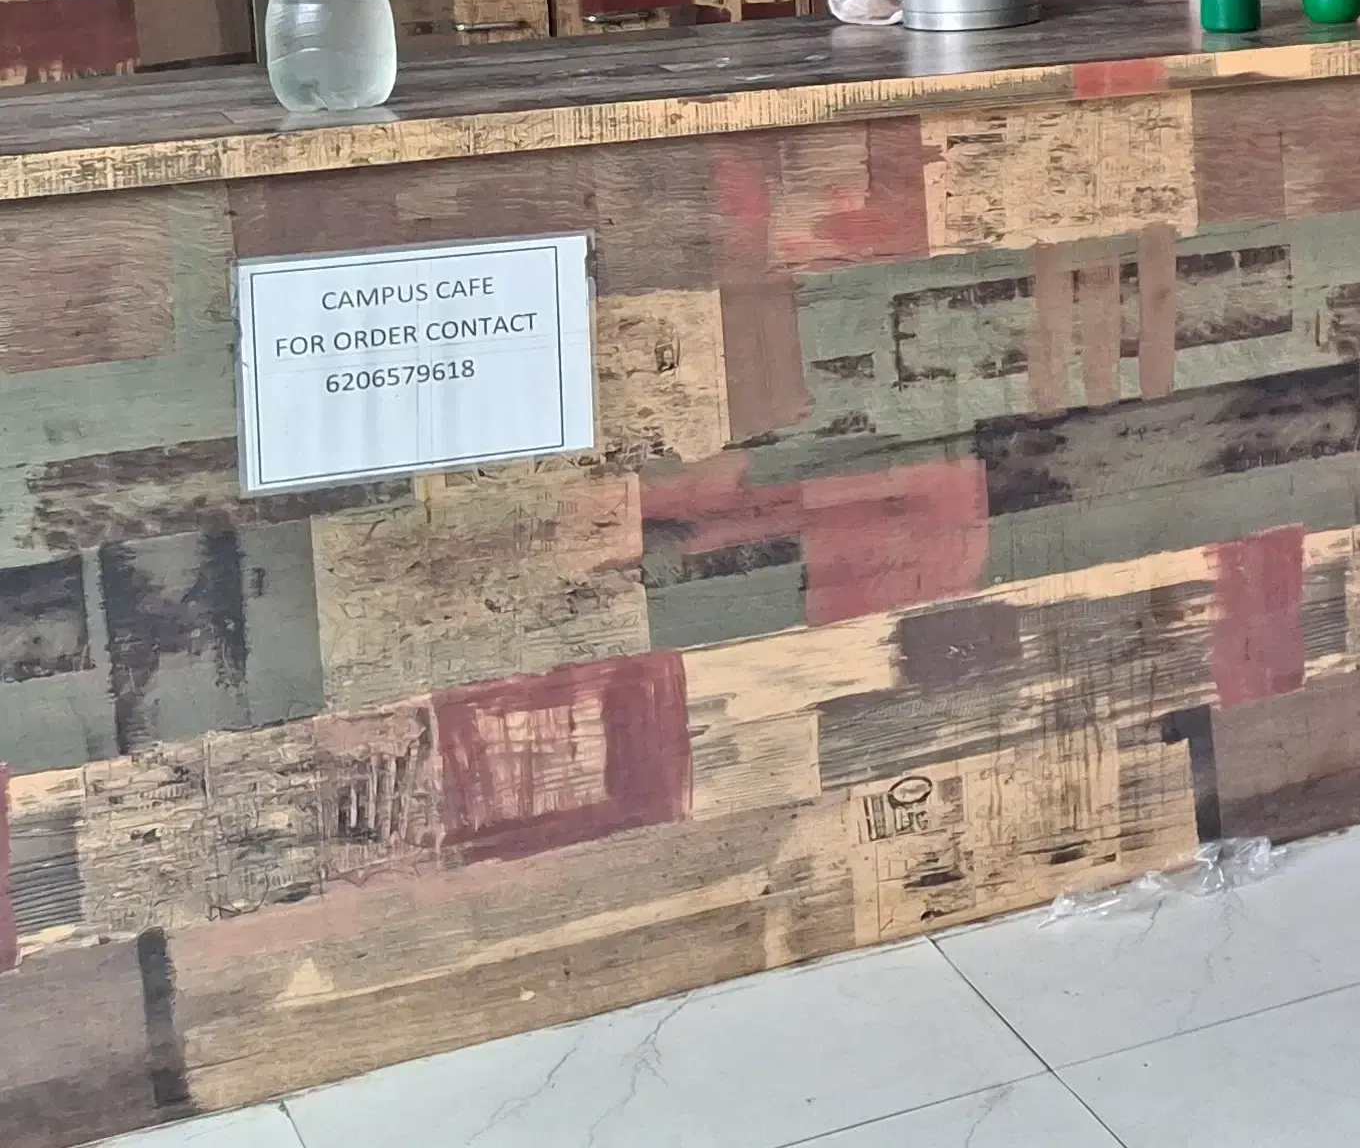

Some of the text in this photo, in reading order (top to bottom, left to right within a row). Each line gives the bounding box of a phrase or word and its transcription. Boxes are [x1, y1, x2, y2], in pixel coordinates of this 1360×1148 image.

[321, 276, 494, 311] CAMPUS CAFE
[275, 312, 538, 357] FOR ORDER CONTACT
[325, 359, 476, 394] 6206579618
